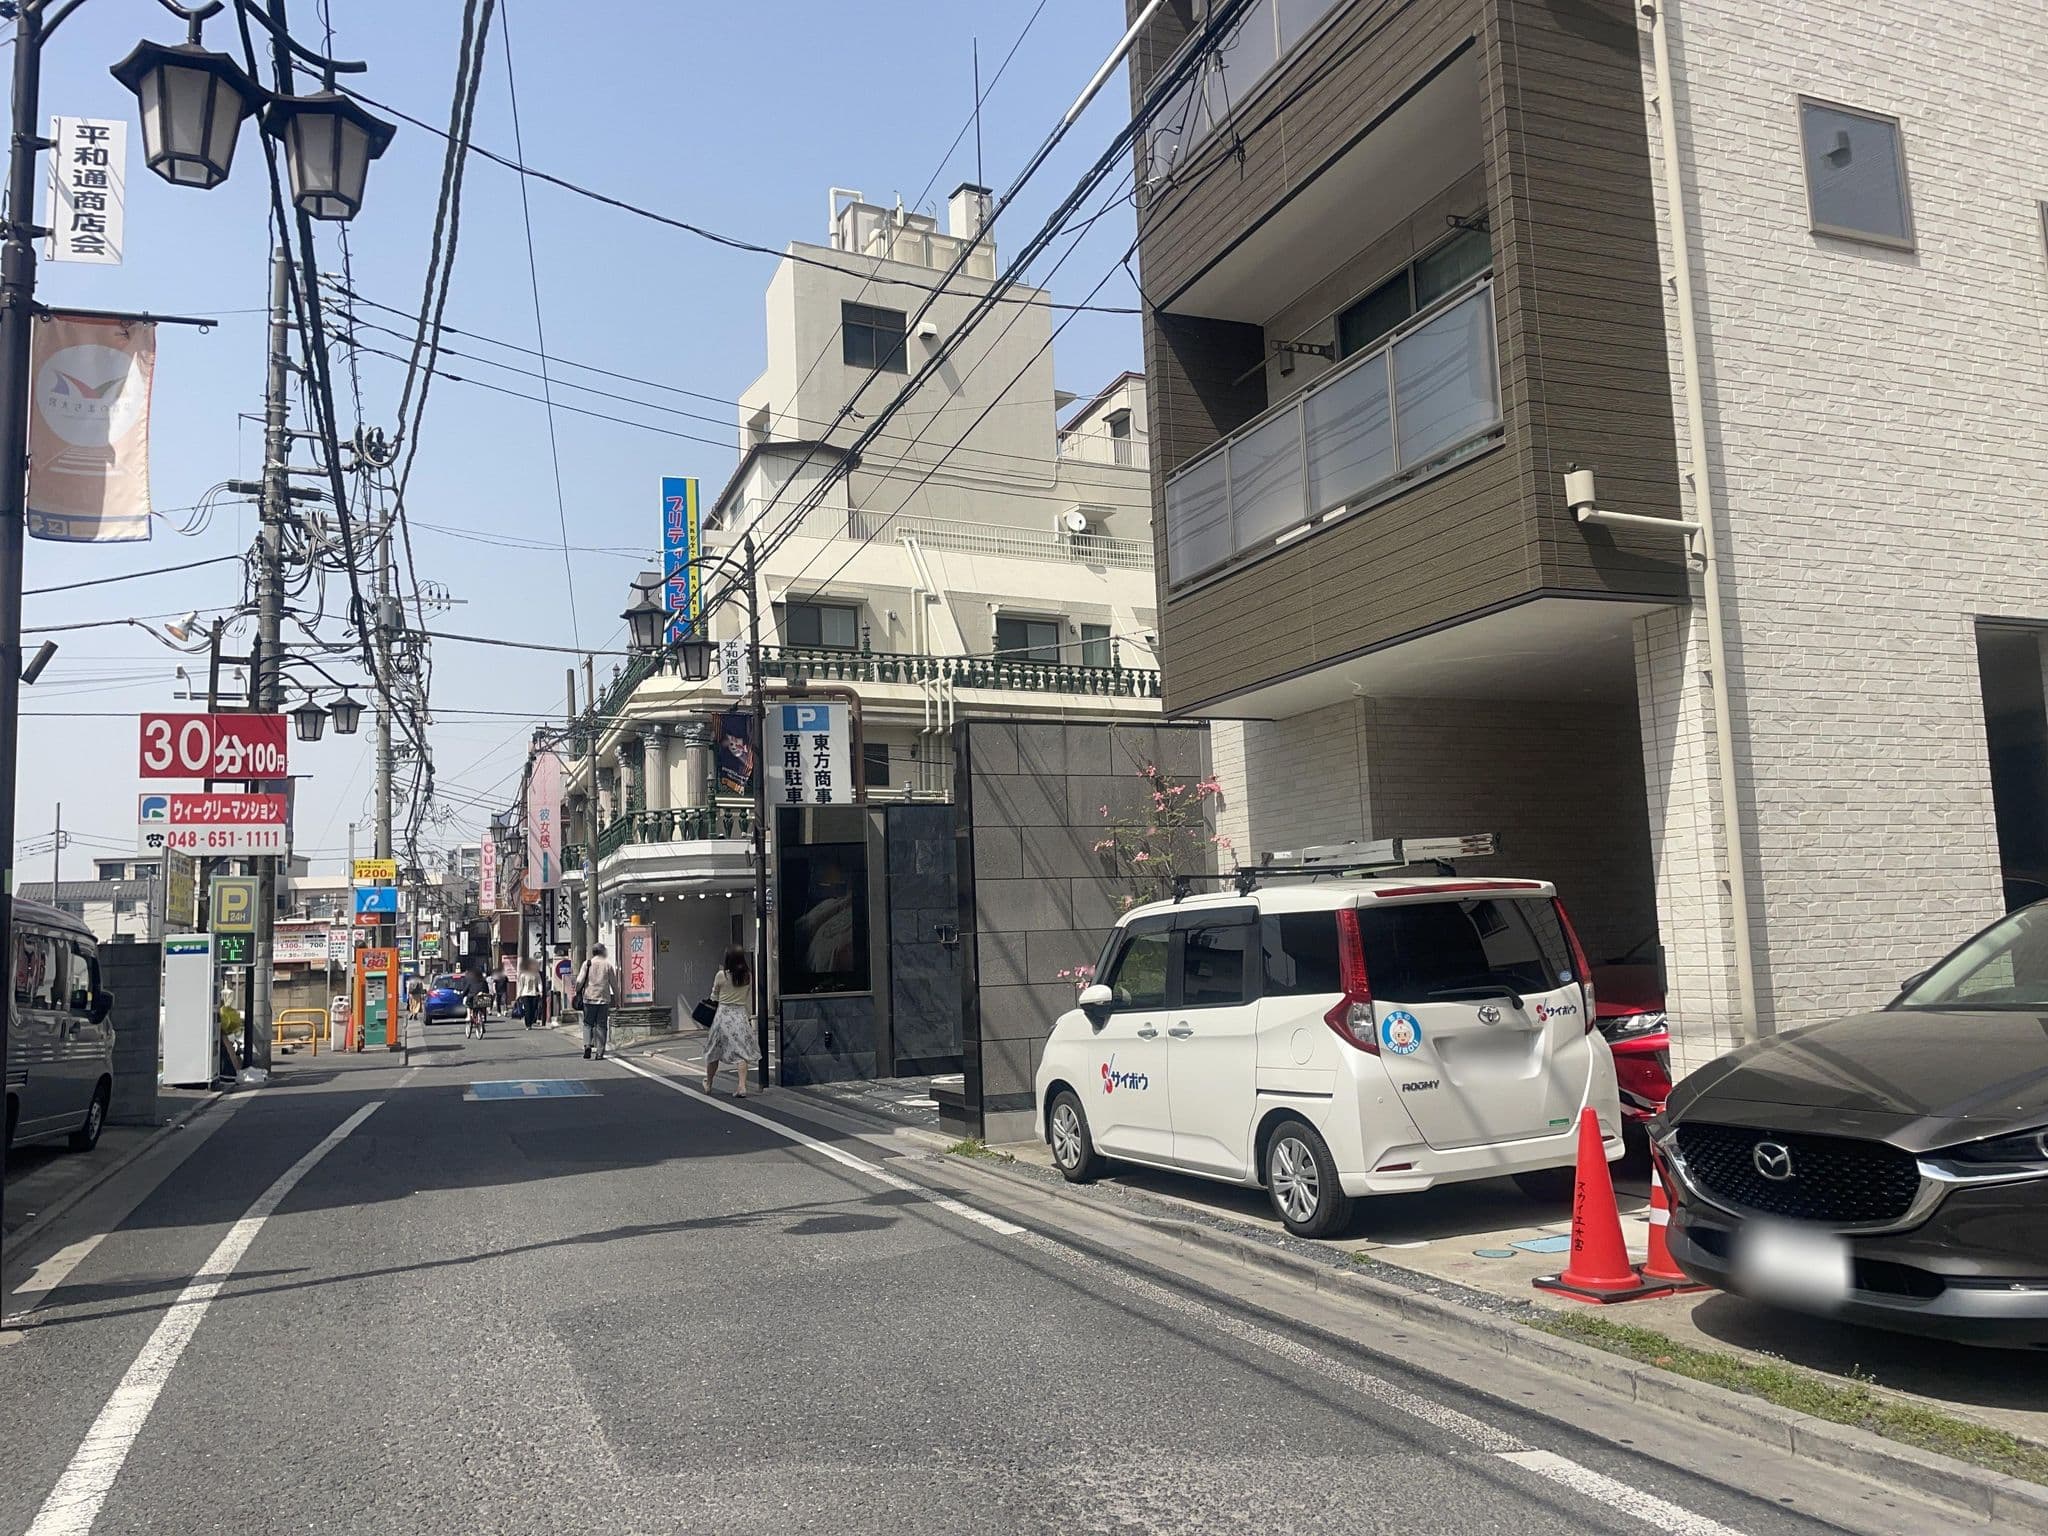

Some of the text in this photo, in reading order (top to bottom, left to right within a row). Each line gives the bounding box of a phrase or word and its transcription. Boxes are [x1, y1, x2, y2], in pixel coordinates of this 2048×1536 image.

[70, 124, 110, 256] 平和通商店会
[726, 642, 740, 692] 平和通商店会
[783, 734, 803, 804] 専用駐車
[812, 734, 832, 804] 東方商事
[173, 800, 279, 821] ウィークリーマンション
[167, 831, 279, 848] 048-651-1111
[631, 936, 645, 990] 彼女感
[1546, 1004, 1577, 1017] サイボウ
[1110, 1071, 1149, 1091] サイボウ
